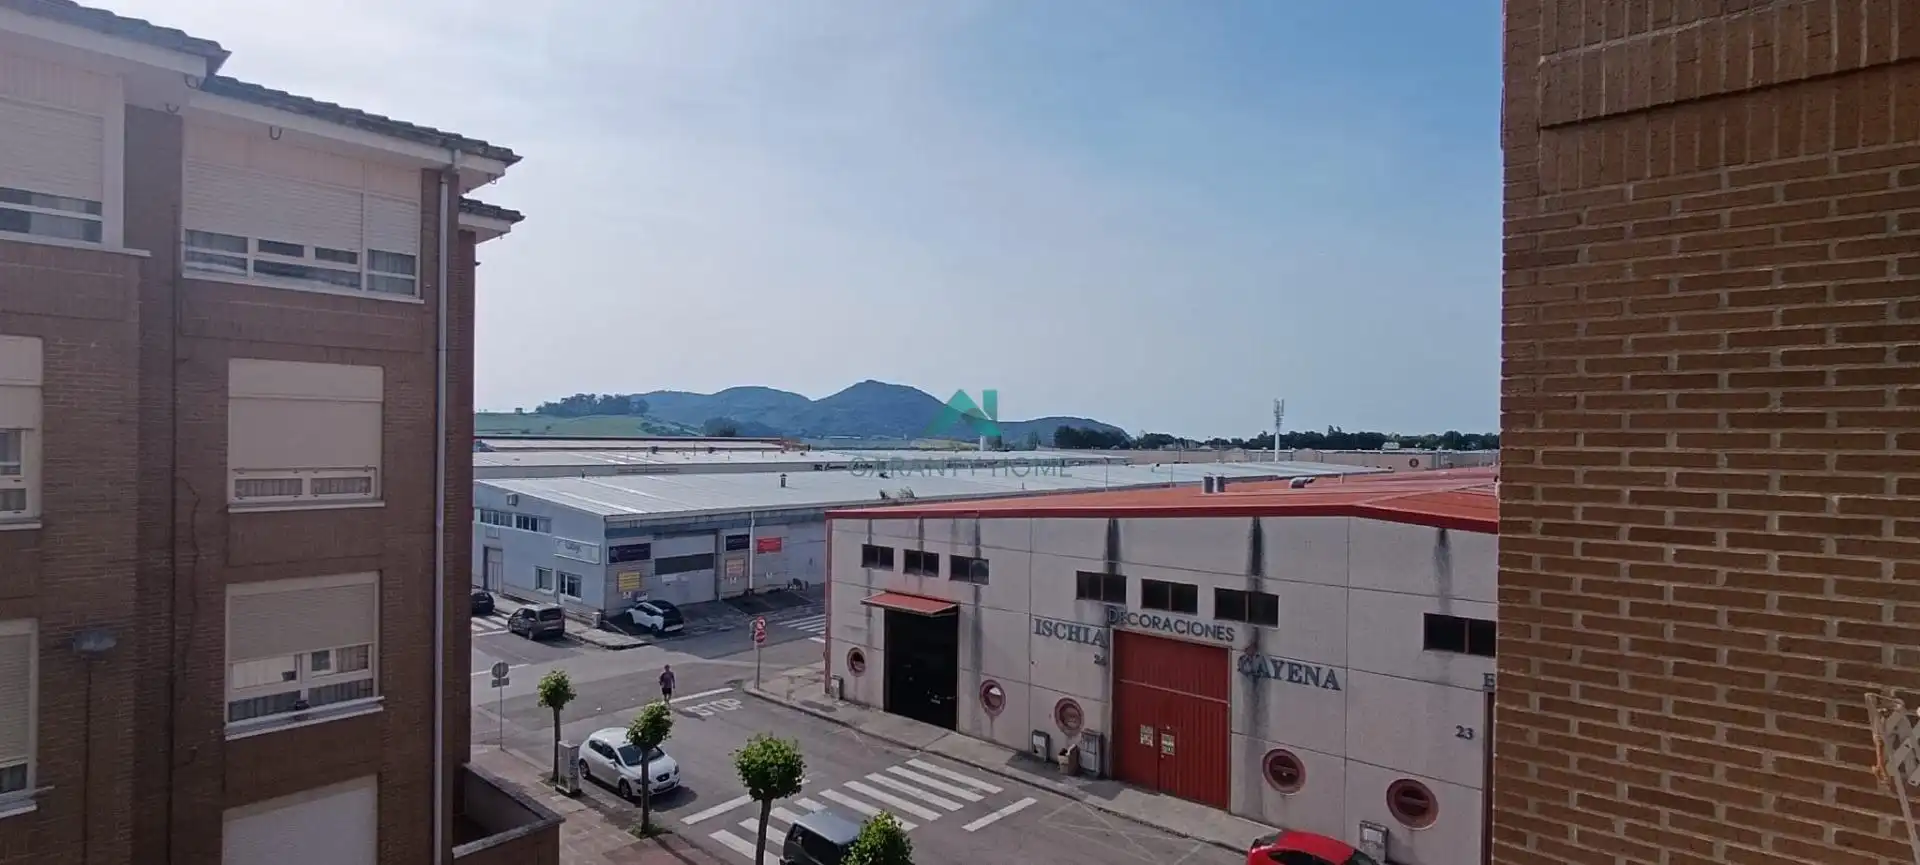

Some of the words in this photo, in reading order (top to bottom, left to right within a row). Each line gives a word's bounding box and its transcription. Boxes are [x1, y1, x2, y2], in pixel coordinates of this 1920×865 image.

[1033, 618, 1109, 649] ISCHIA
[1107, 607, 1235, 642] DECORACIONES
[1237, 652, 1342, 691] CAYENA
[685, 698, 743, 716] STOP
[1455, 724, 1473, 740] 23
